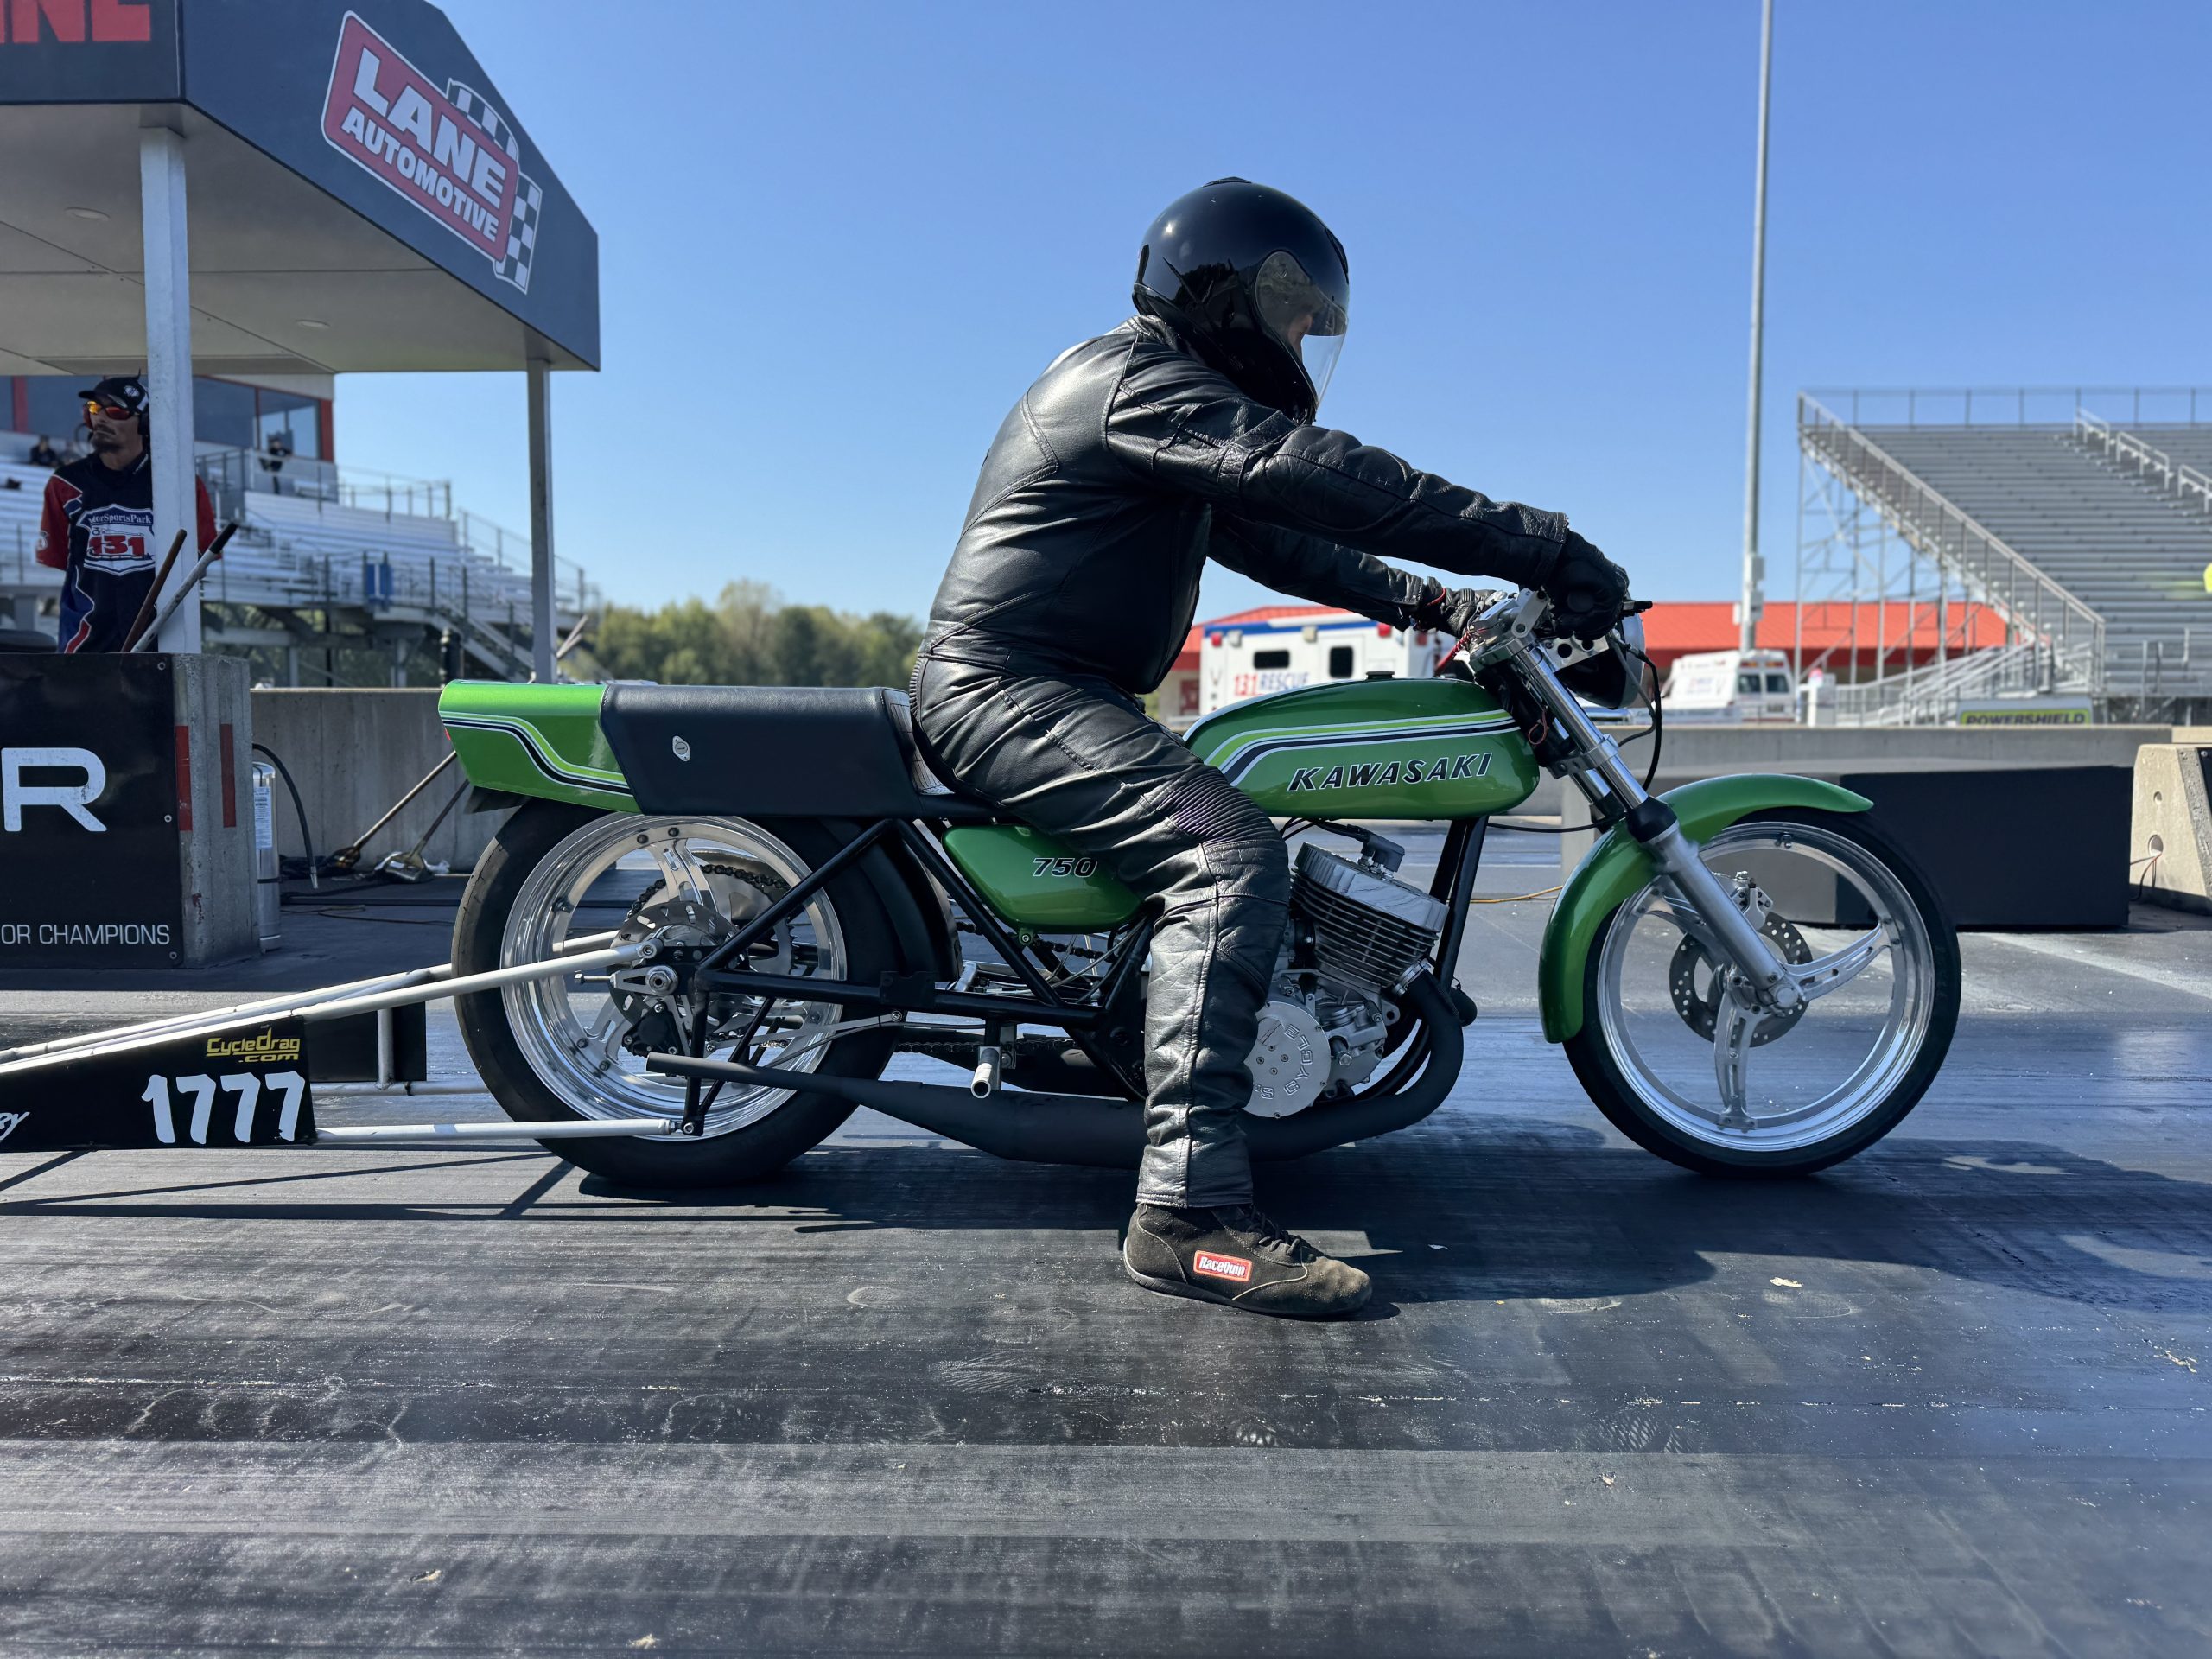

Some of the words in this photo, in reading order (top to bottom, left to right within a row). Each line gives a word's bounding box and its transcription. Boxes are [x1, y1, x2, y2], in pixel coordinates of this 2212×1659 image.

[353, 47, 506, 210] LANE
[340, 105, 499, 243] AUTOMOTIVE
[88, 535, 145, 557] 131
[1235, 674, 1257, 696] 131
[1965, 712, 2086, 725] POWERSHIELD
[1287, 752, 1492, 792] KAWASAKI
[1, 747, 107, 832] R
[1032, 857, 1098, 878] 750
[1, 924, 31, 944] OR
[39, 924, 170, 944] CHAMPIONS
[206, 1027, 301, 1057] CycleDrag
[238, 1053, 299, 1063] .com
[141, 1071, 306, 1144] 1777
[1198, 1256, 1247, 1276] RaceQuip
